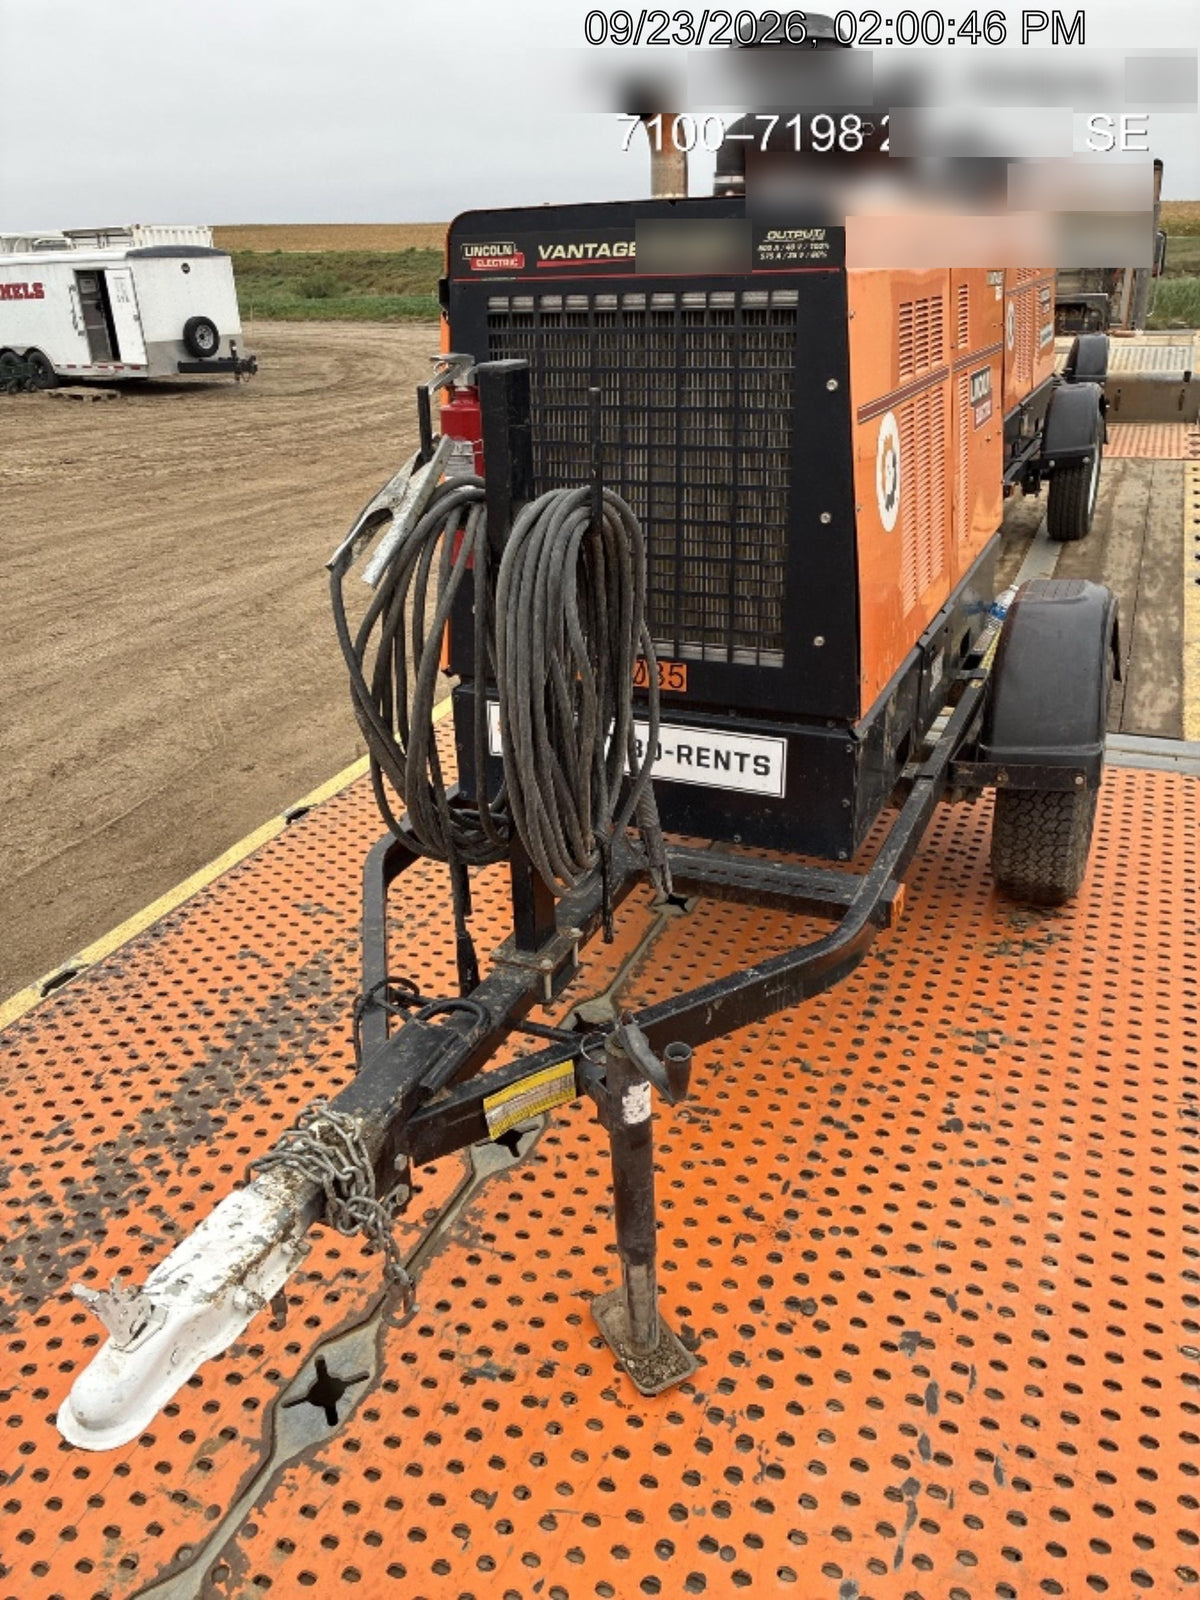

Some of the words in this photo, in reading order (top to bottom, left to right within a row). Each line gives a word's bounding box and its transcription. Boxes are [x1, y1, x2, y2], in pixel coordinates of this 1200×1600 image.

[766, 229, 821, 240] OUTPUT
[464, 244, 512, 257] LINCOLN
[476, 258, 519, 268] ELECTRIC
